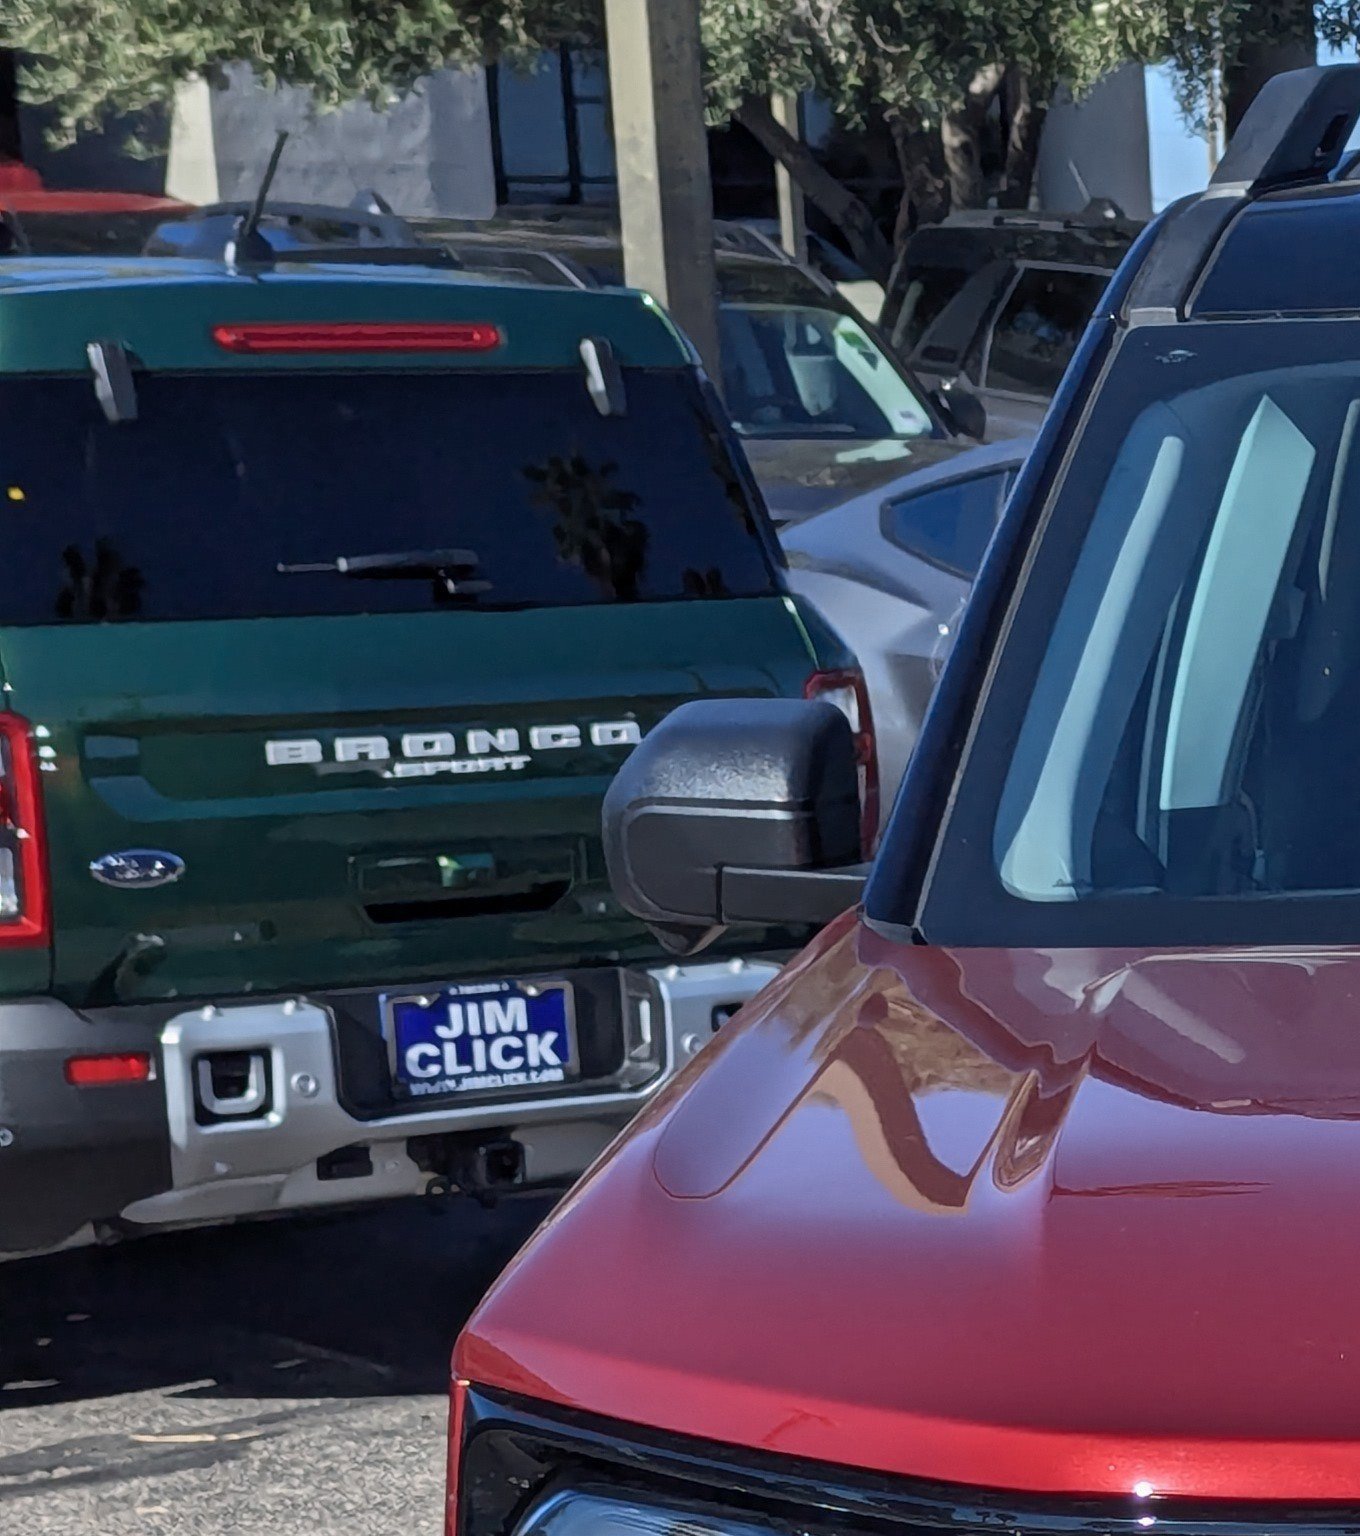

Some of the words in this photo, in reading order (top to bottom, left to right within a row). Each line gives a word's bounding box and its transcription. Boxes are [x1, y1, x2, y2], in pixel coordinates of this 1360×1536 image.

[264, 719, 645, 766] BRONCO
[386, 754, 532, 778] SPORT
[434, 997, 528, 1039] JIM
[405, 1031, 562, 1078] CLICK
